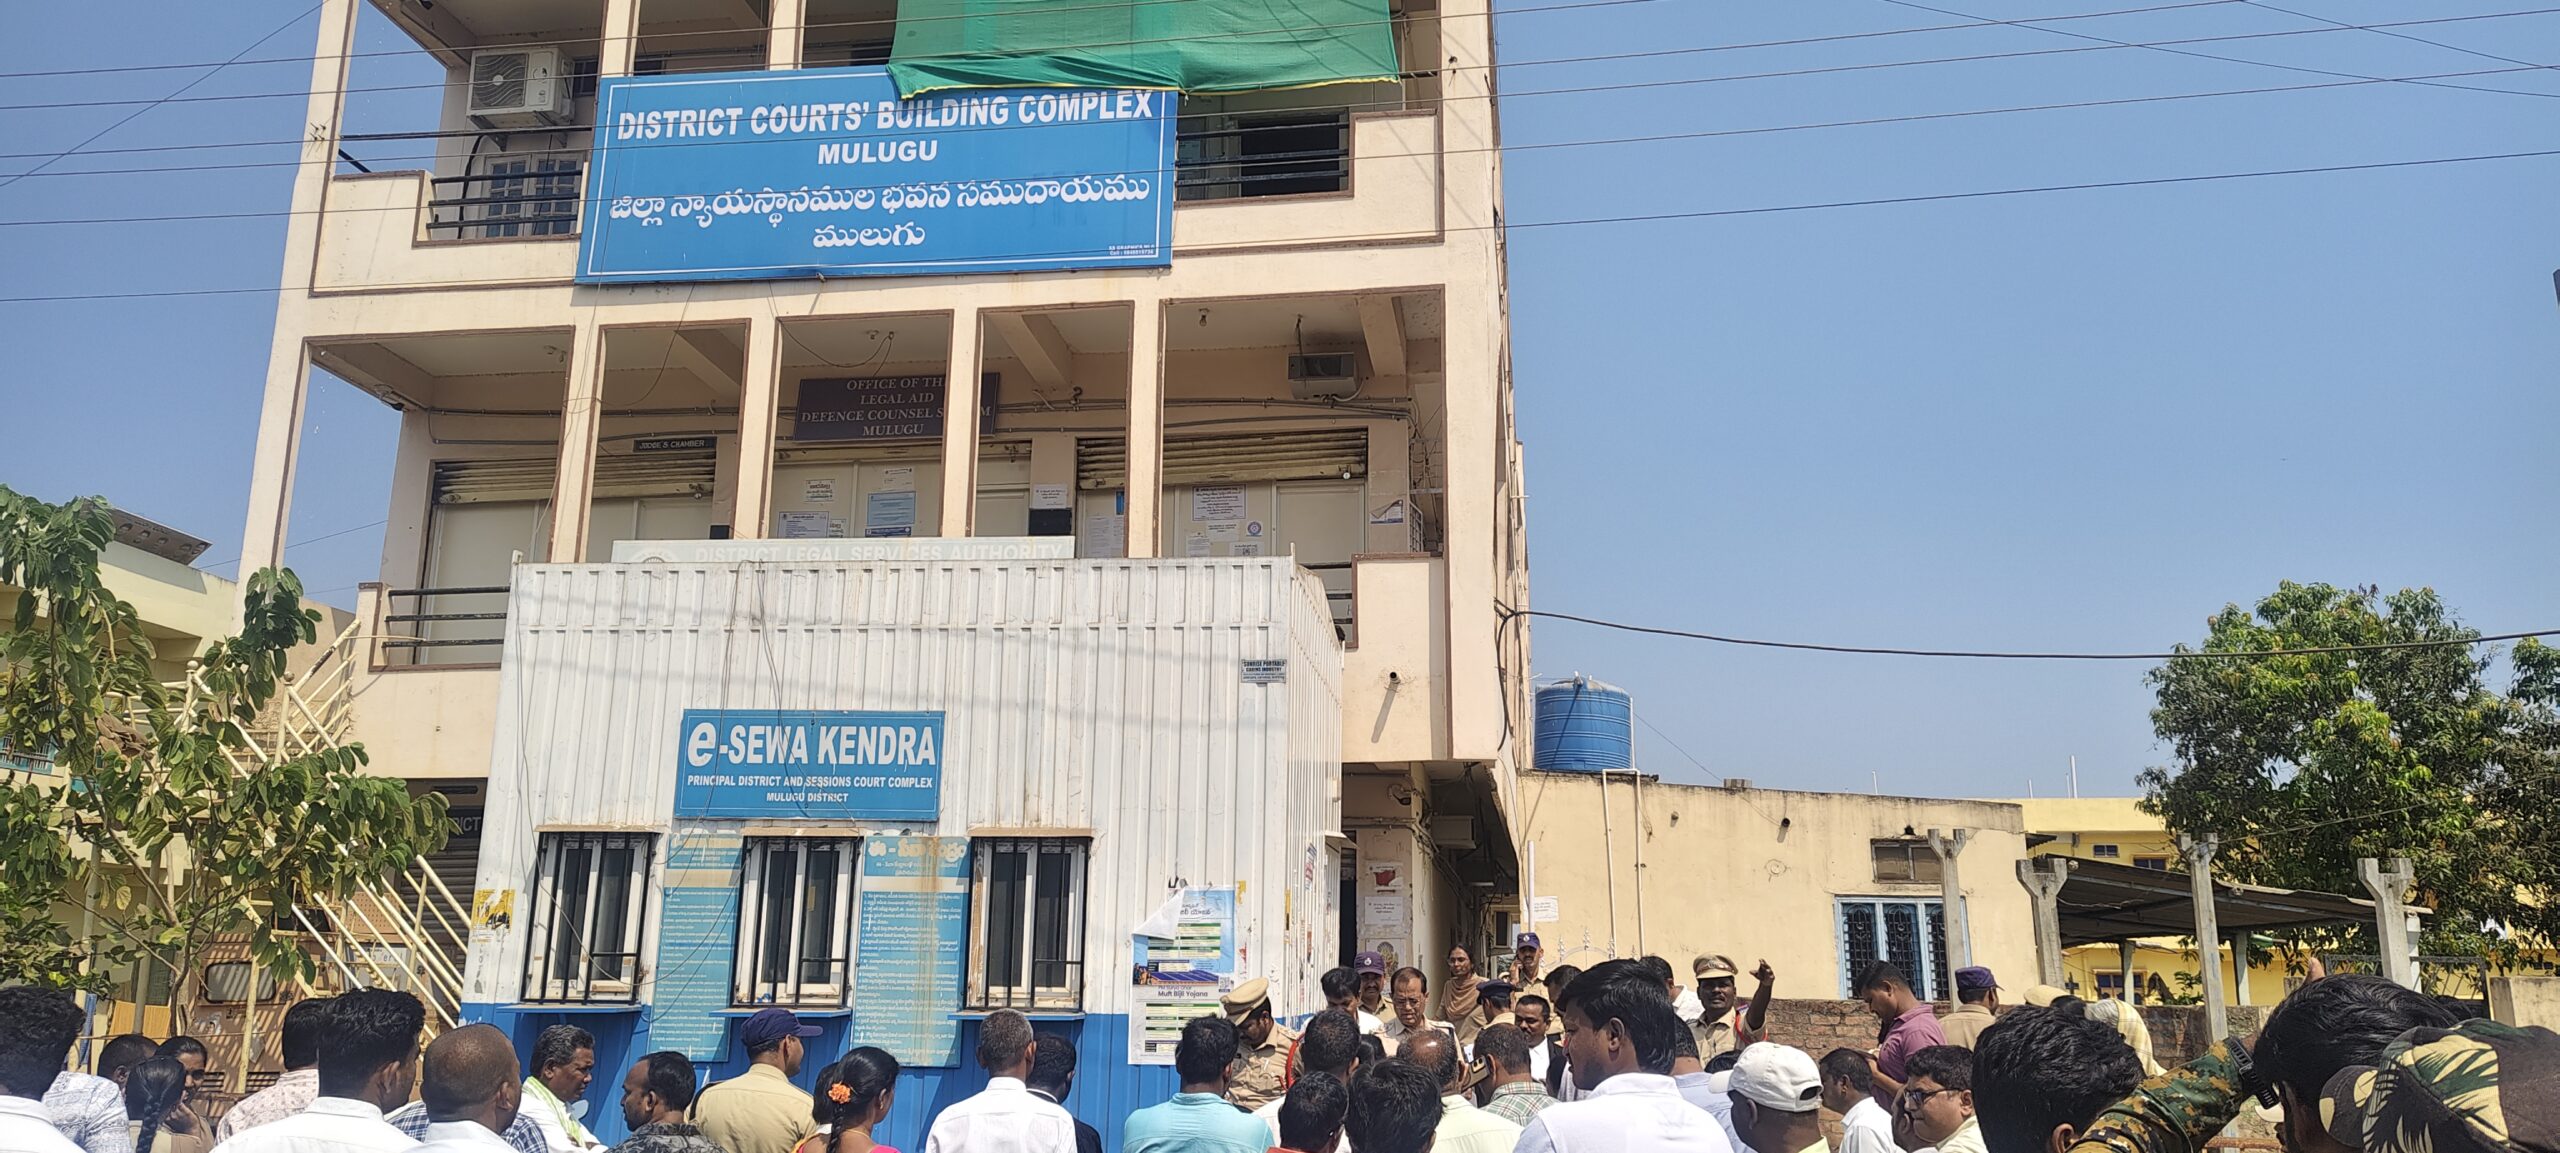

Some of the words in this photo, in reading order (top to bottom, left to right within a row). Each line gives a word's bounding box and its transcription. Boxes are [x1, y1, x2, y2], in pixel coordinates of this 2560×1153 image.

[617, 107, 743, 140] DISTRICT
[877, 95, 1009, 129] BUILDING
[1018, 89, 1153, 124] COMPLEX
[818, 140, 938, 165] MULUGU
[609, 195, 666, 226] జిల్లా
[670, 185, 875, 229] న్యాయస్థానముల
[881, 180, 950, 214] భవన
[957, 174, 1150, 208] సముదాయము
[812, 221, 926, 248] ములుగు
[847, 379, 897, 391] OFFICE
[900, 378, 918, 389] OF
[922, 377, 944, 388] TH
[860, 393, 905, 405] LEGAL
[909, 392, 935, 404] AID
[801, 410, 865, 422] DEFENCE
[868, 408, 933, 421] COUNSEL
[863, 423, 924, 436] MULUGU
[670, 440, 705, 448] CHAMBER
[696, 545, 779, 562] DISTRICT
[786, 545, 840, 562] LEGAL
[850, 544, 943, 561] SERVICES
[950, 544, 1062, 560] AUTHORITY
[687, 721, 809, 767] e-SEWA
[817, 725, 936, 766] KENDRA
[688, 775, 736, 786] PRINCIPAL
[738, 775, 781, 787] DISTRICT
[783, 775, 803, 787] AND
[804, 776, 851, 788] SESSIONS
[853, 776, 886, 788] COURT
[888, 777, 933, 788] COMPLEX
[766, 792, 805, 802] MULUGU
[807, 792, 849, 803] DISTRICT
